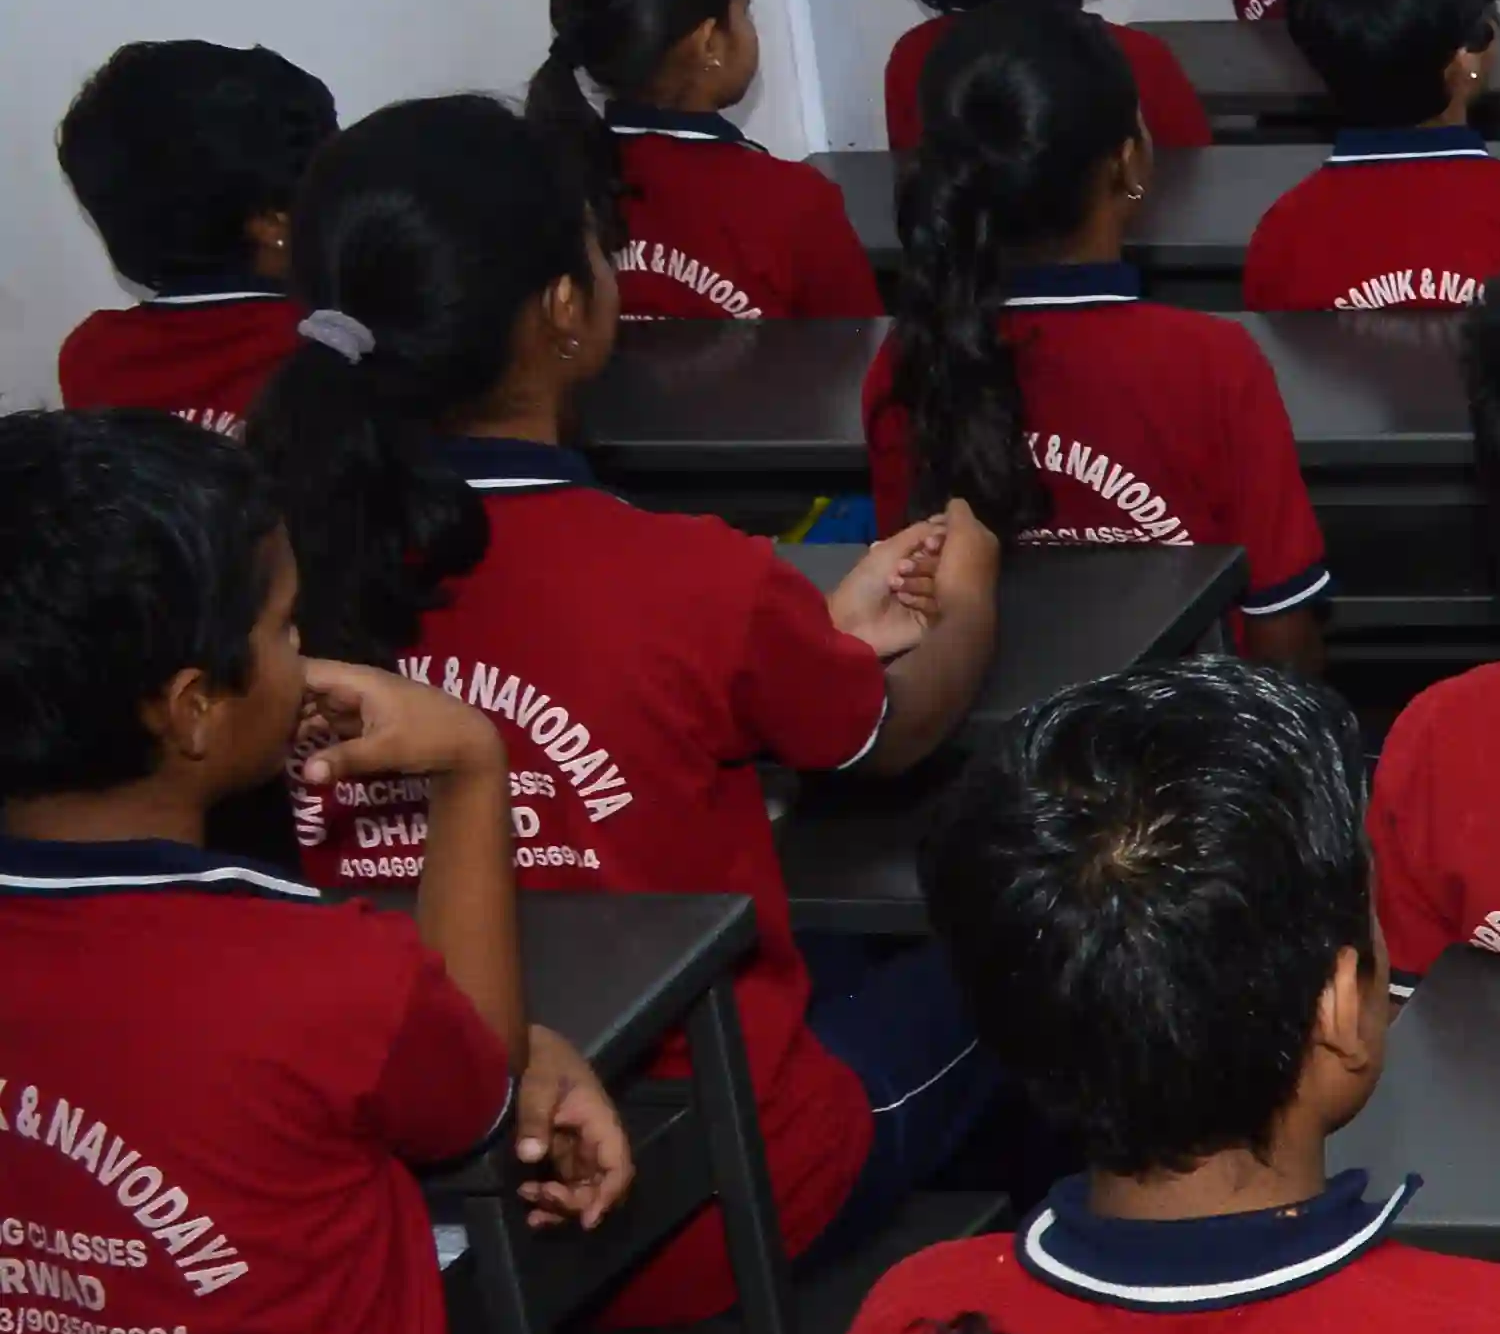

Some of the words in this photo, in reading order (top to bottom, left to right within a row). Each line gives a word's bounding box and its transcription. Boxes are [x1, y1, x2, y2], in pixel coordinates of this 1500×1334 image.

[650, 244, 665, 273] &
[667, 248, 762, 319] NAVOD
[1420, 268, 1435, 299] &
[1045, 434, 1062, 473] &
[443, 657, 463, 700] &
[469, 662, 633, 822] NAVODAYA
[16, 1085, 41, 1140] &
[46, 1098, 249, 1297] NAVODAYA
[28, 1222, 148, 1267] CLASSES
[0, 1258, 106, 1311] RWAD
